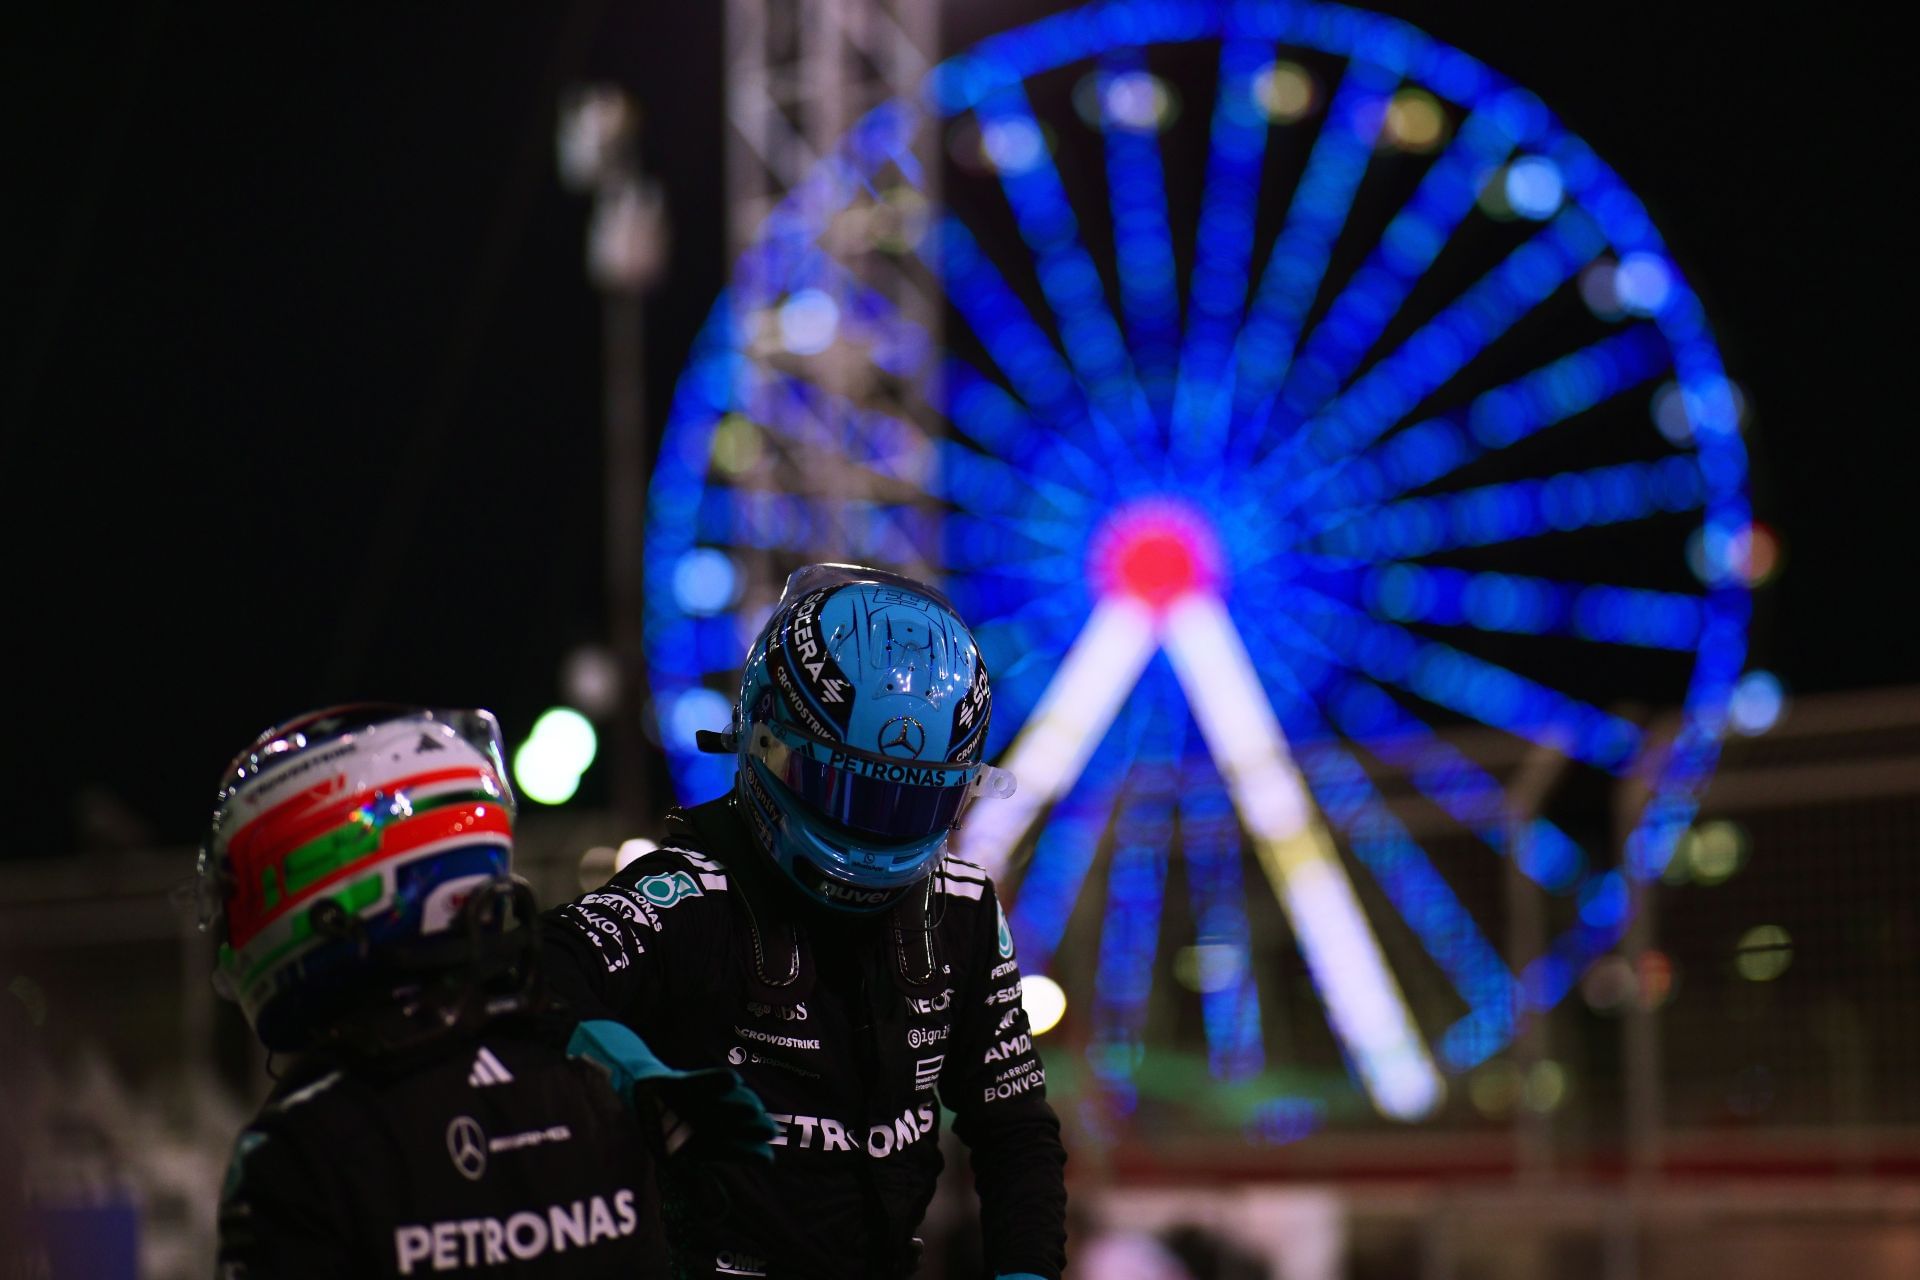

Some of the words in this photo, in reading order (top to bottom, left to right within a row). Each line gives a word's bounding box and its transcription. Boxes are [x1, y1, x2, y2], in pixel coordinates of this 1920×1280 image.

[829, 751, 946, 787] PETRONAS
[741, 1028, 821, 1051] CROWDSTRIKE
[984, 1069, 1046, 1103] BONVOY
[995, 1059, 1036, 1083] MARRIOTT
[394, 1188, 639, 1276] PETRONAS
